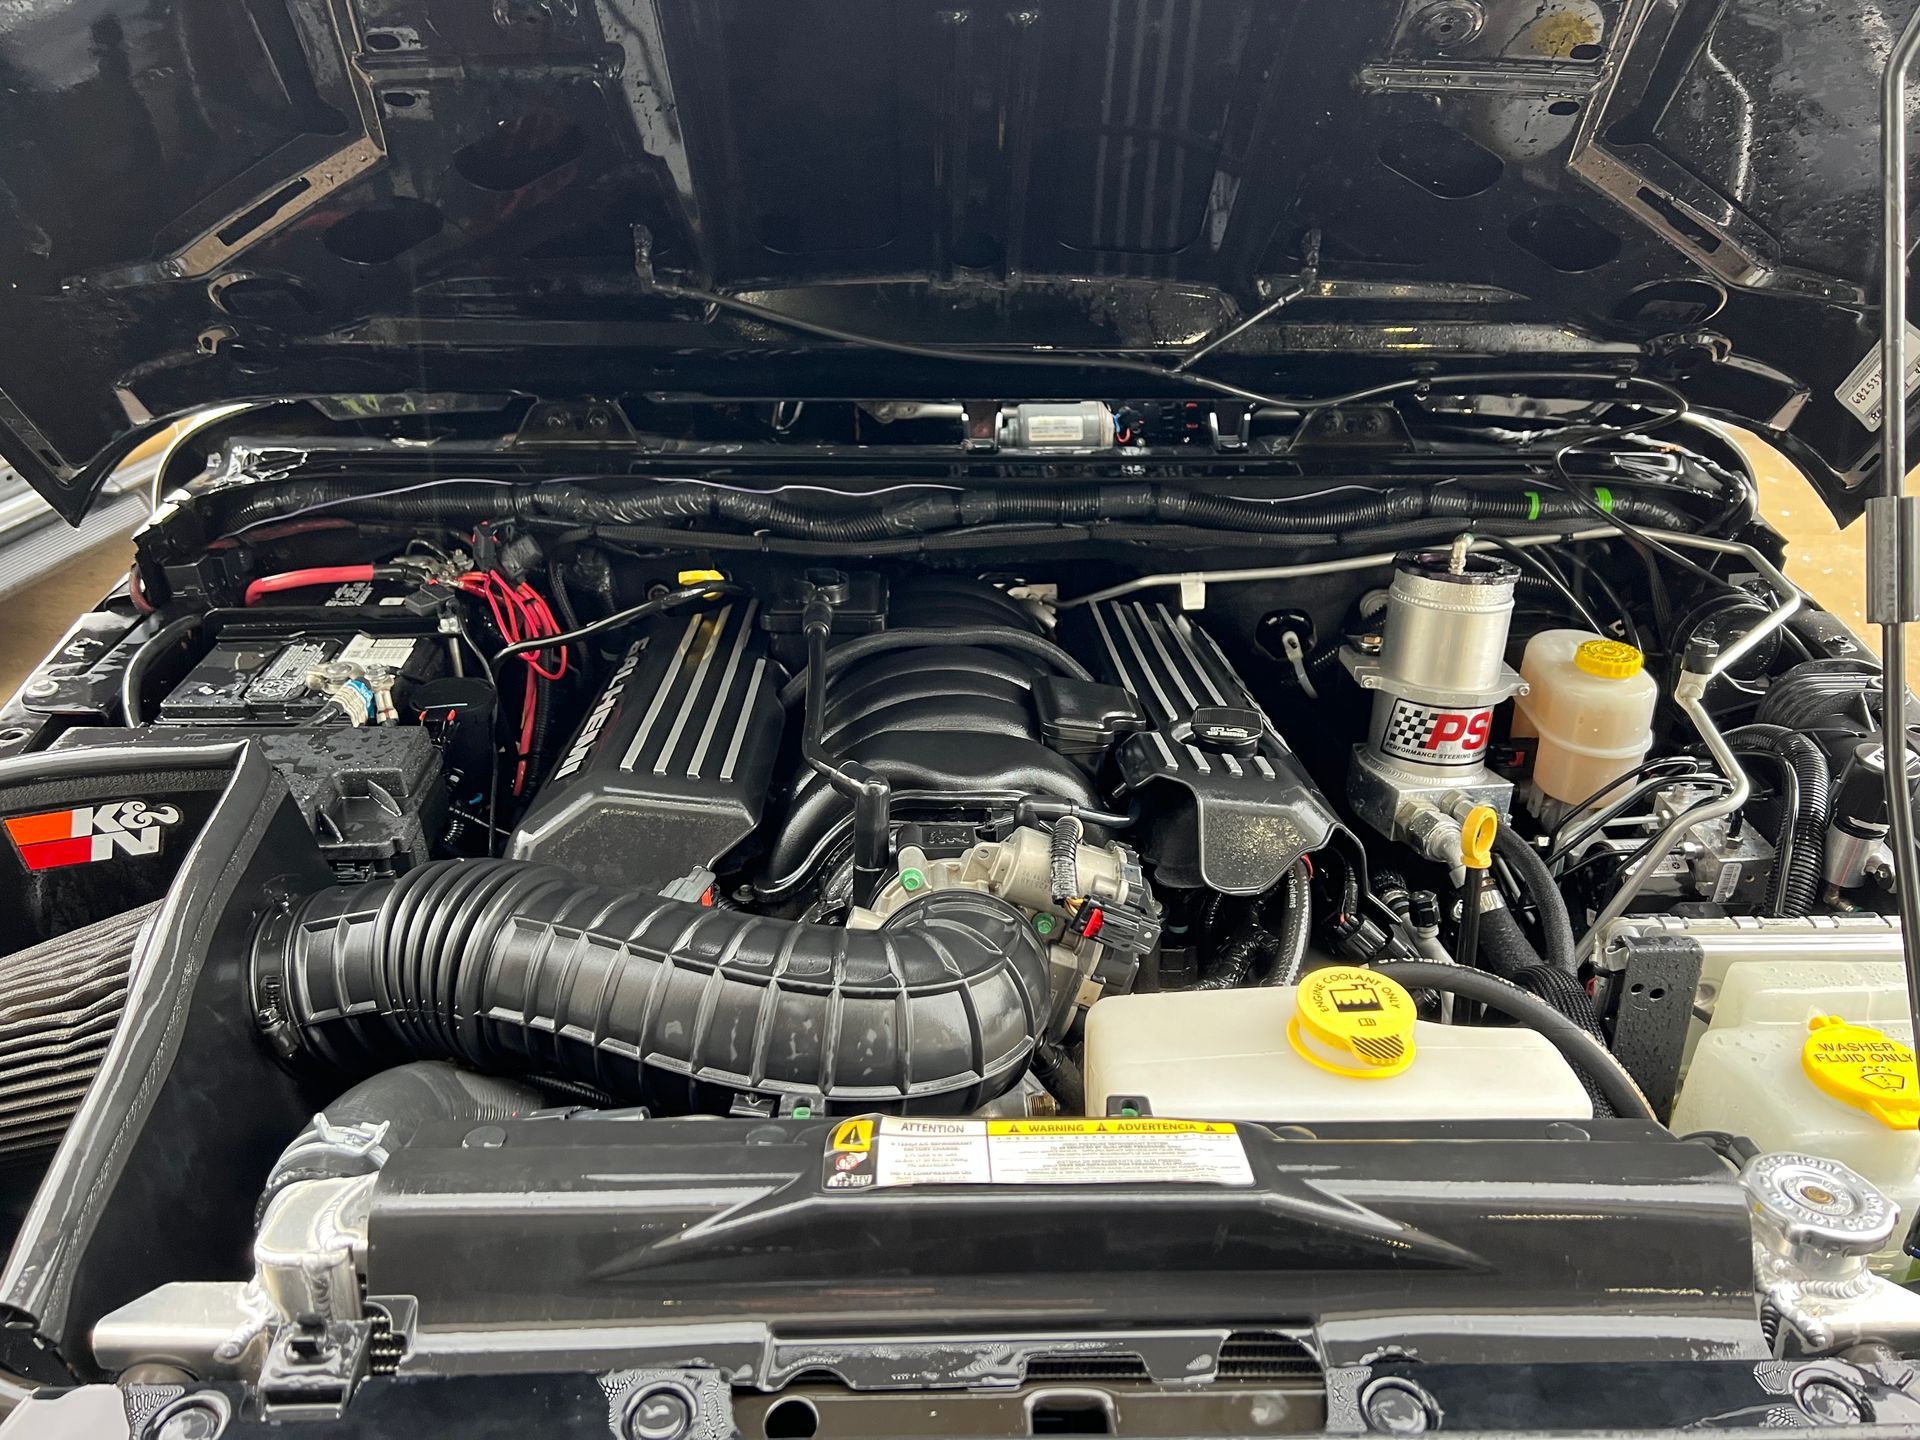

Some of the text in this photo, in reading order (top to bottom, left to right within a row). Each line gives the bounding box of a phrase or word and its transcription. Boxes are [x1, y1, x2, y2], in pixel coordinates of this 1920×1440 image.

[554, 683, 624, 781] HEMI
[1385, 742, 1437, 759] PERFORMANCE
[1438, 752, 1471, 760] STEERING
[71, 800, 180, 862] K&N
[1313, 973, 1400, 1013] ENGINE COOLANT ONLY
[1817, 1042, 1895, 1052] WASHER
[1814, 1053, 1914, 1063] FLUID ONLY
[900, 1122, 965, 1133] ATTENTION
[1028, 1123, 1197, 1132] WARNING ADVERTENCIA
